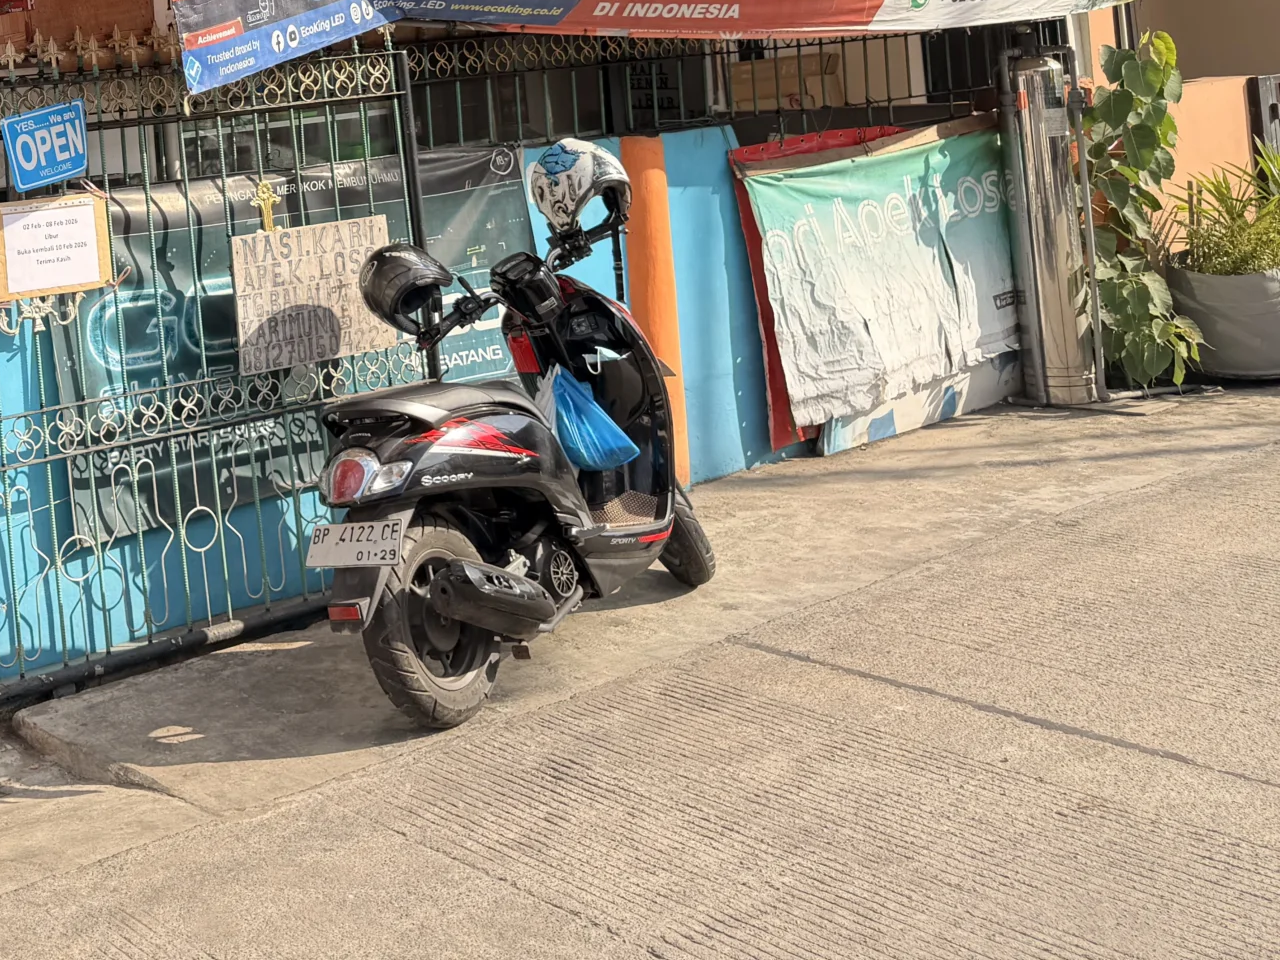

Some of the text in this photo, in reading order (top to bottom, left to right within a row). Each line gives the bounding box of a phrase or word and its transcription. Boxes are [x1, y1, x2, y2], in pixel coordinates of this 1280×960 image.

[451, 3, 563, 16] www.ecoking.co.id
[593, 2, 740, 18] DI INDONESIA
[197, 26, 236, 45] Achievement
[300, 13, 345, 38] EcoKing LED
[207, 40, 260, 65] Trusted Brand by
[220, 57, 256, 76] Indonesian
[48, 114, 62, 124] We
[16, 119, 84, 171] OPEN
[39, 161, 72, 177] WELCOME
[833, 174, 934, 258] Apek
[32, 246, 55, 254] kembali
[439, 345, 503, 370] BATANG
[108, 440, 163, 469] PARTY
[313, 522, 399, 545] BP 4122 CE
